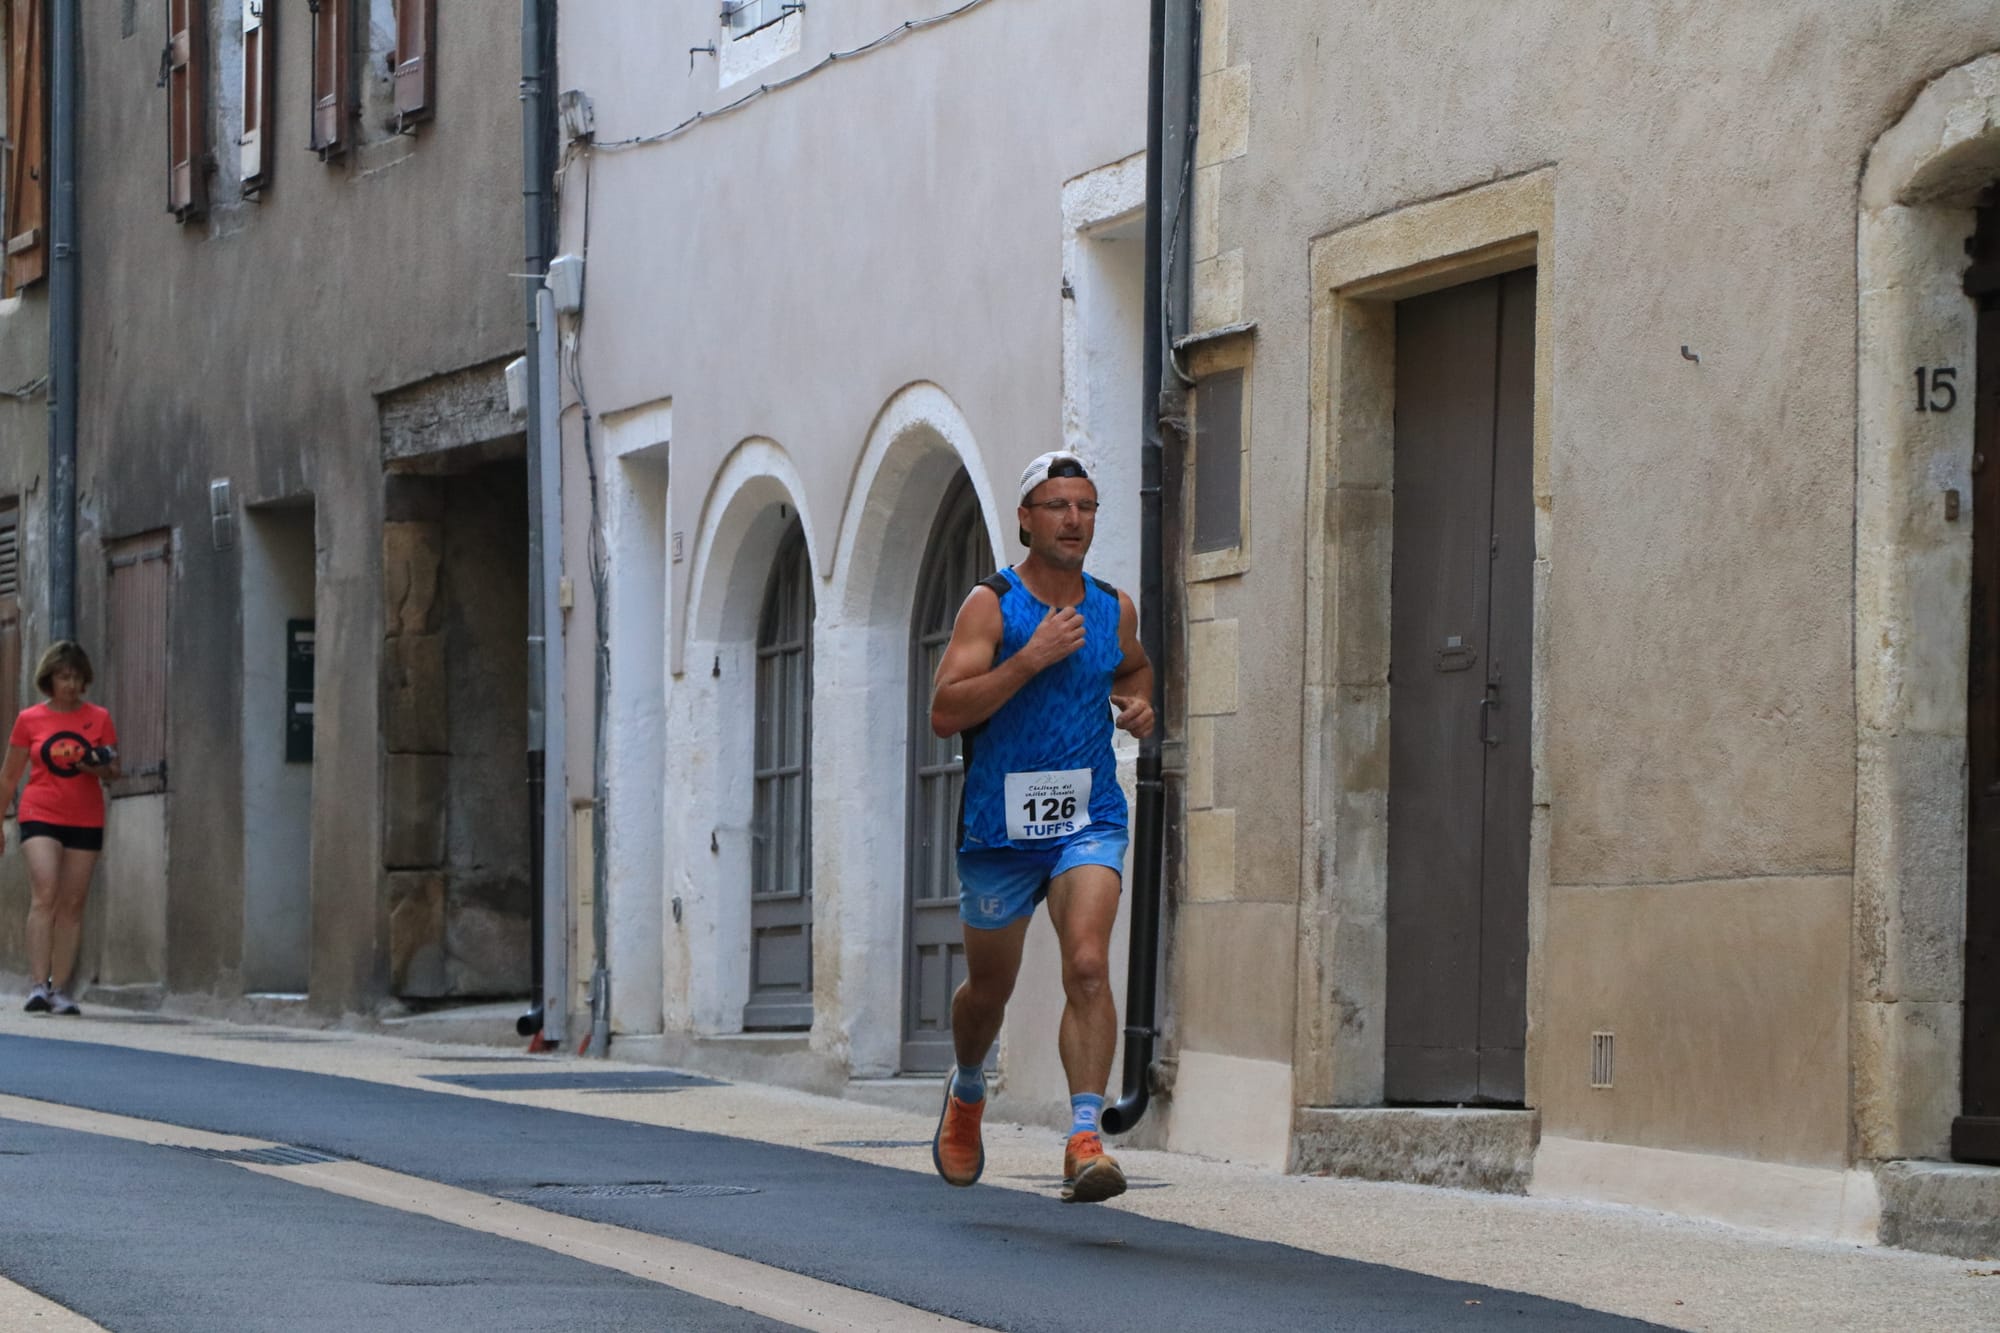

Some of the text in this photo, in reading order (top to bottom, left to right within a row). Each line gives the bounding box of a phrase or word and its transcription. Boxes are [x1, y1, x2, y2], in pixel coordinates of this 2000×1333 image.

[1914, 366, 1957, 413] 15
[1023, 797, 1077, 822] 126
[1023, 821, 1075, 836] TUFF'S
